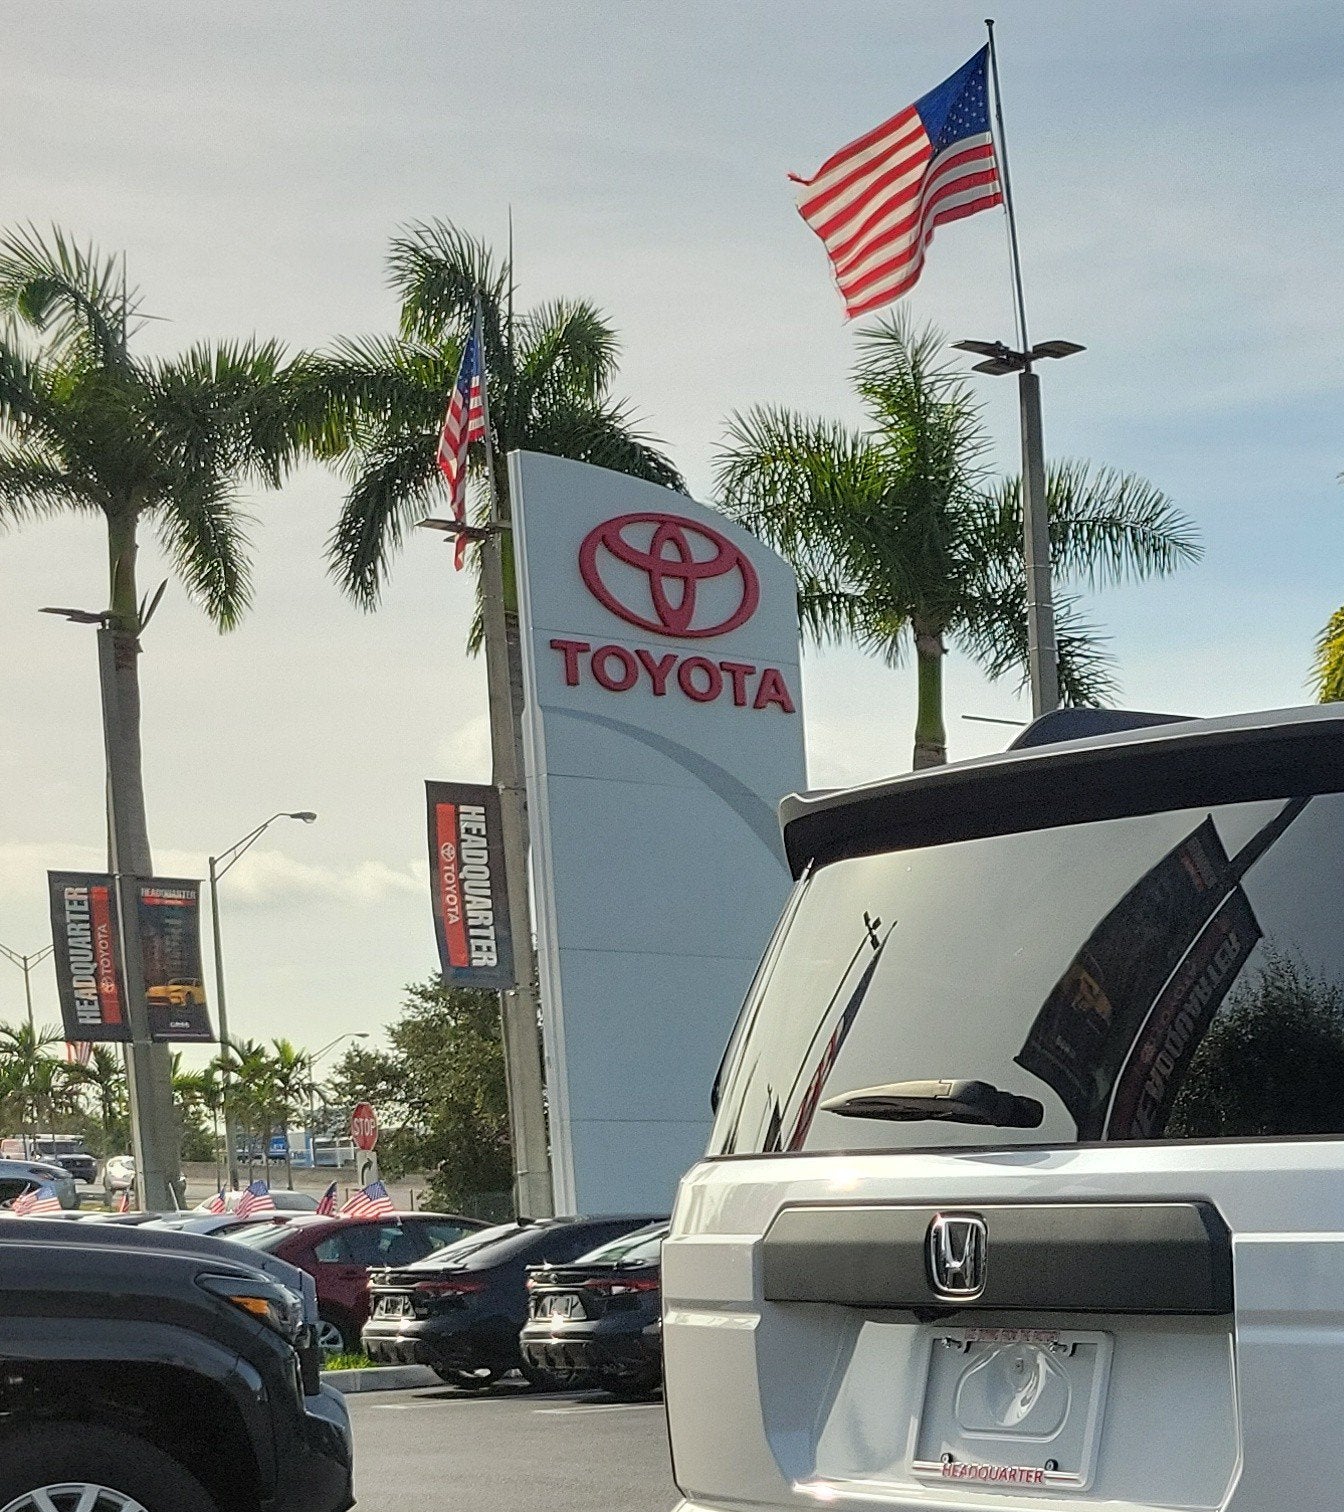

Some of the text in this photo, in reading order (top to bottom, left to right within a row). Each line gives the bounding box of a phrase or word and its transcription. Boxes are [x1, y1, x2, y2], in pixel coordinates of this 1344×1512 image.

[550, 639, 796, 713] TOYOTA
[442, 864, 460, 925] TOYOTA
[459, 805, 497, 967] HEADQUARTER
[64, 887, 102, 1024] HEADQUARTER
[97, 923, 113, 978] TOYOTA
[353, 1118, 375, 1136] STOP
[941, 1463, 1045, 1484] HEADQUARTER
